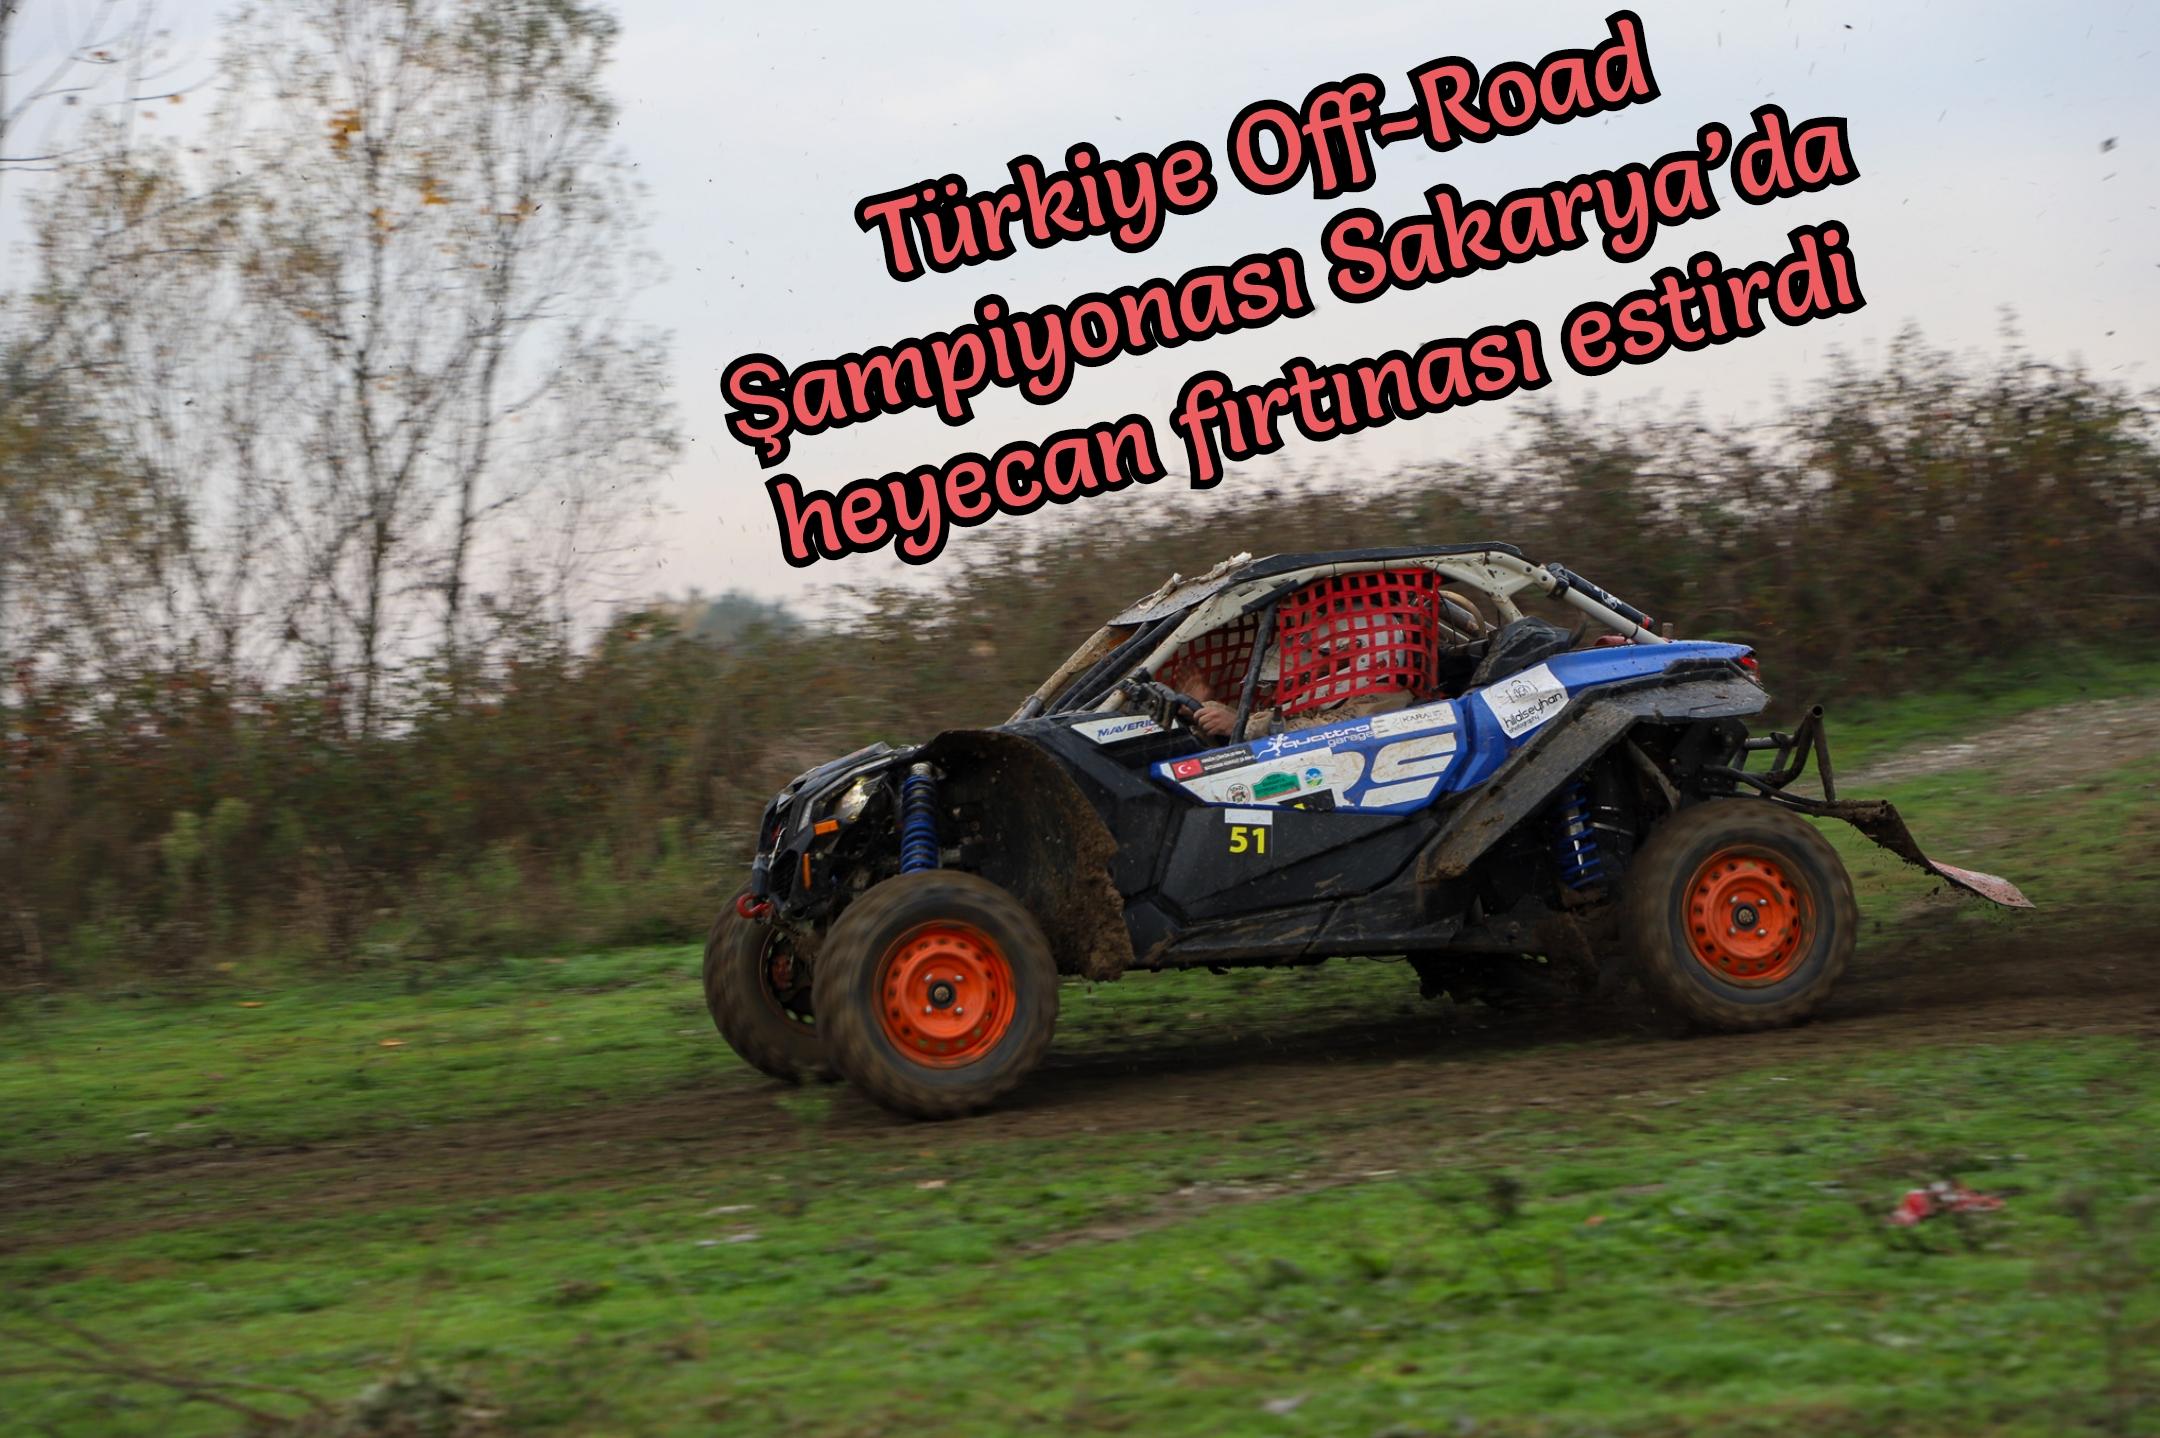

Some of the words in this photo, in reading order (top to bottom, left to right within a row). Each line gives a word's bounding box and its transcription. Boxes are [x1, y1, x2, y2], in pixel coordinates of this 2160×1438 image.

[1283, 724, 1370, 749] quattro
[1327, 730, 1375, 748] garage
[1229, 826, 1265, 854] 51
